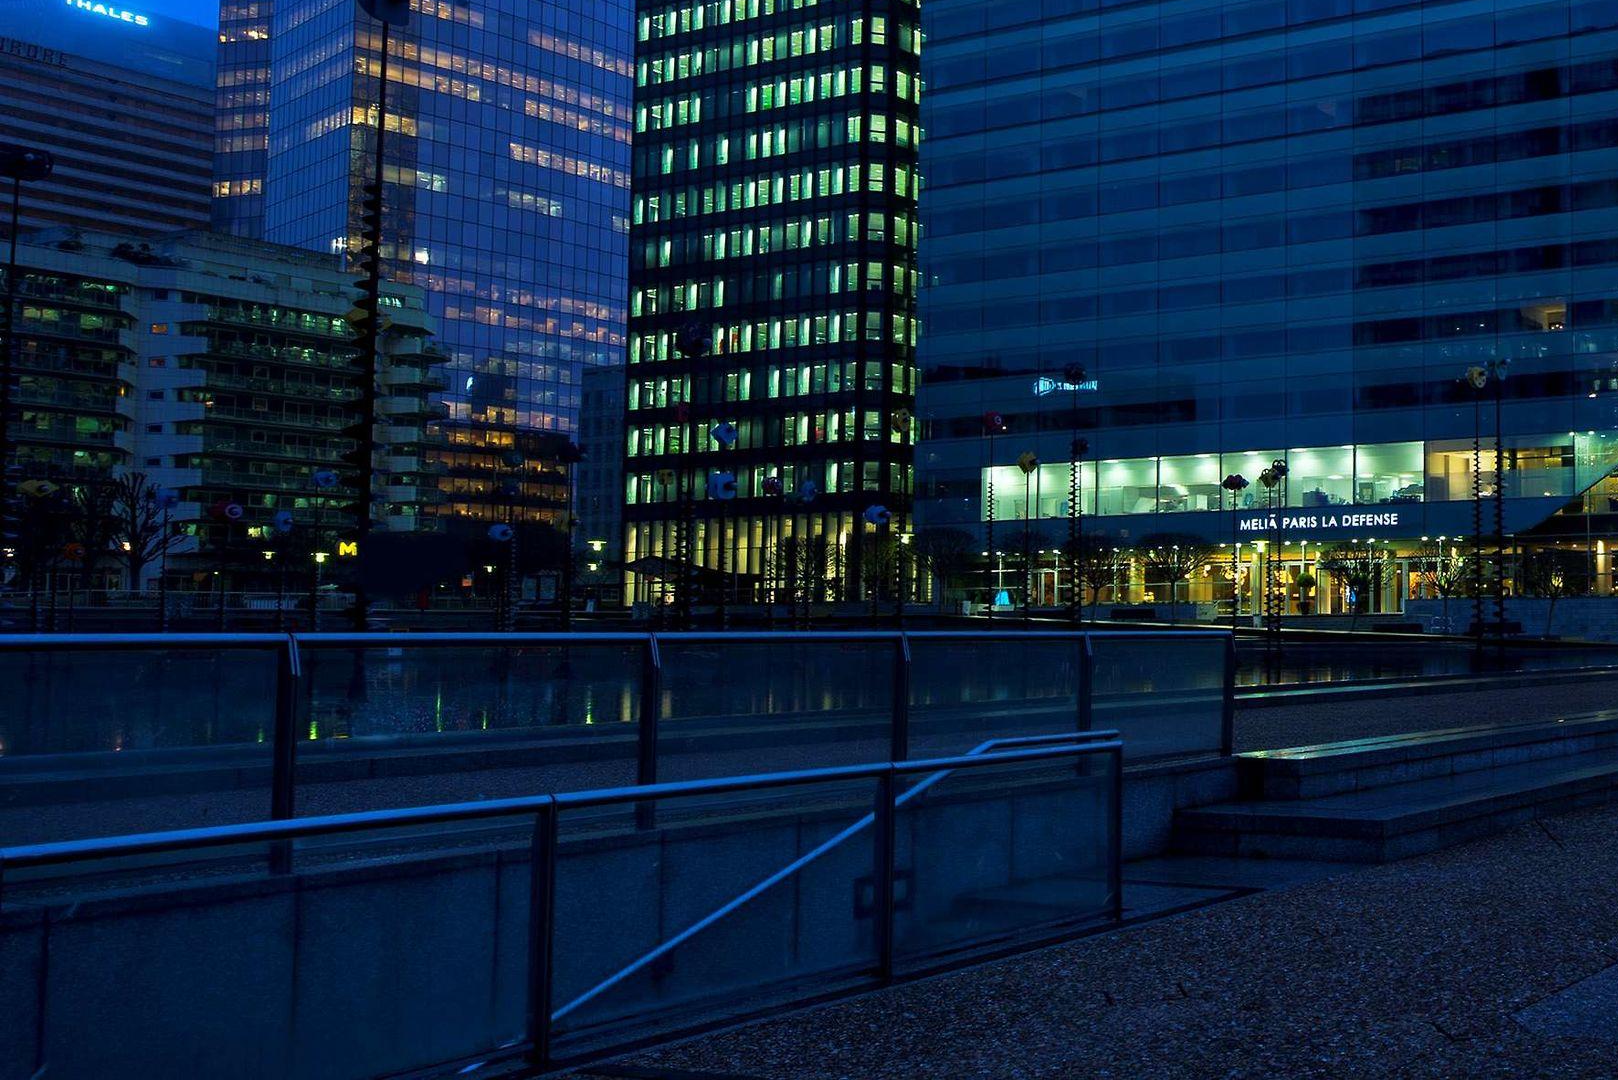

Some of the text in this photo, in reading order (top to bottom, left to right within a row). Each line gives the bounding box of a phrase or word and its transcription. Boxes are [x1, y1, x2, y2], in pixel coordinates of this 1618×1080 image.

[1282, 516, 1317, 529] PARIS
[1322, 515, 1338, 527] LA
[1342, 513, 1398, 527] DEFENSE
[338, 541, 358, 556] M
